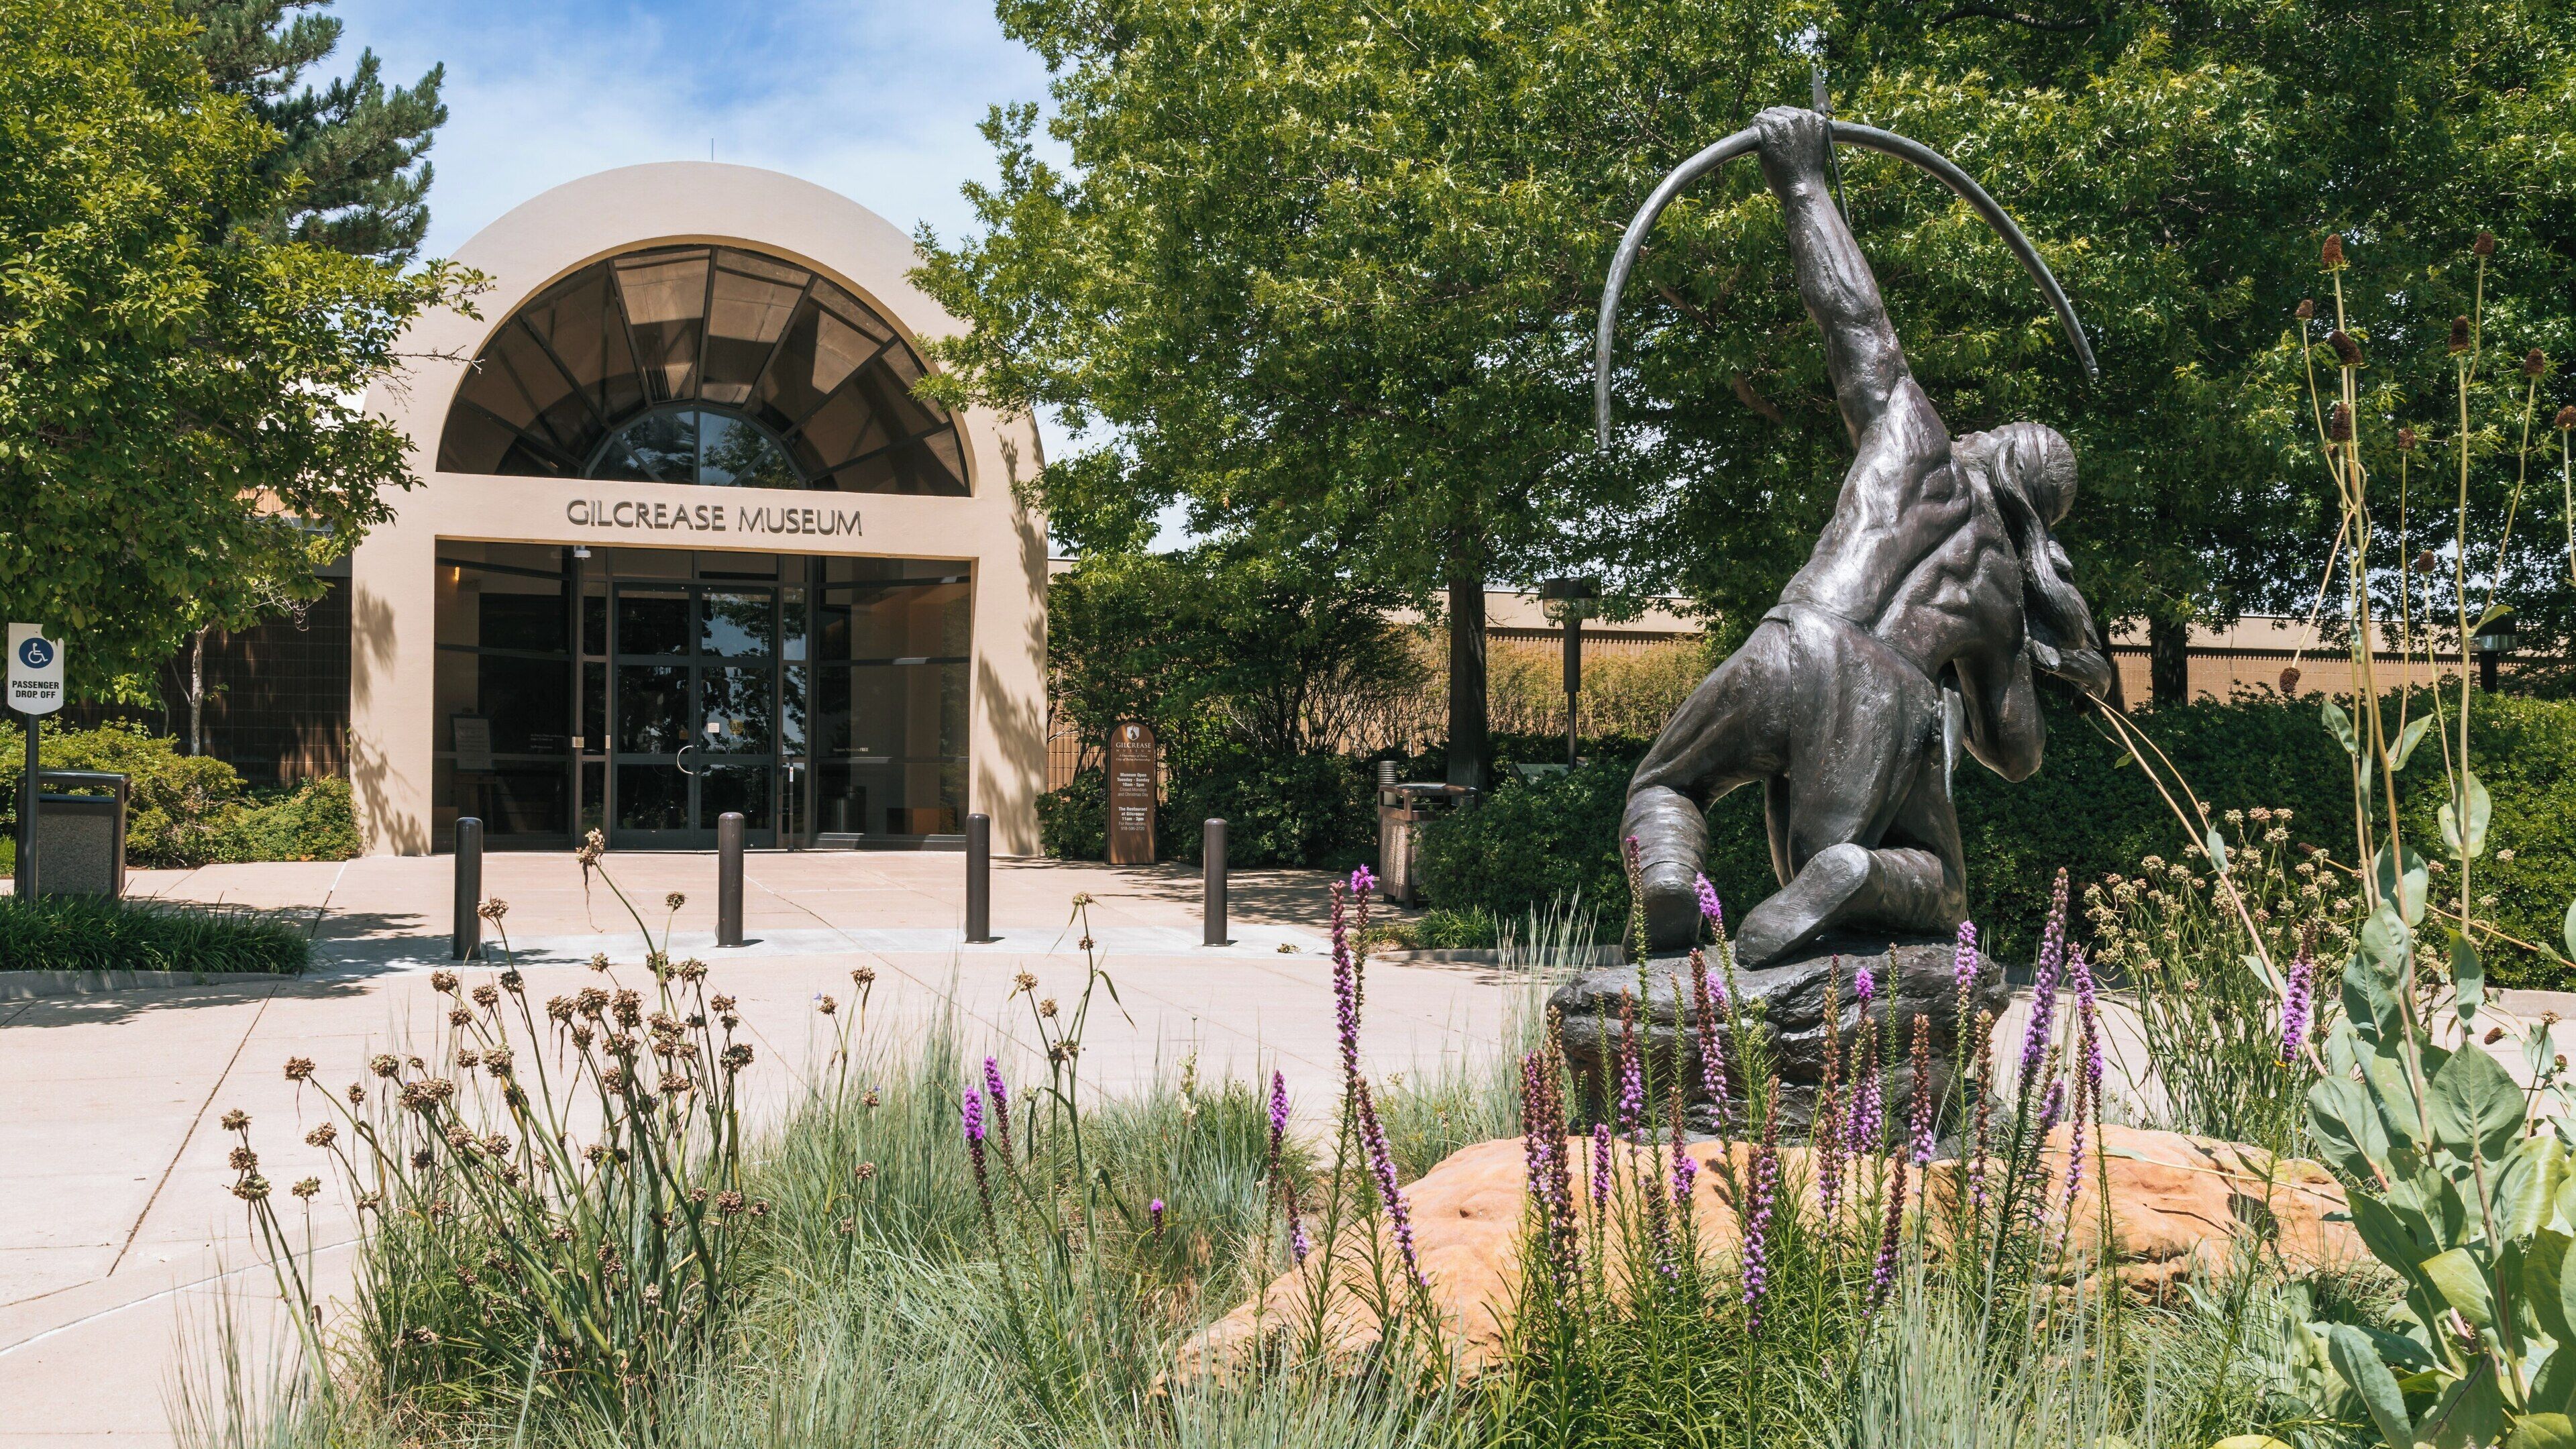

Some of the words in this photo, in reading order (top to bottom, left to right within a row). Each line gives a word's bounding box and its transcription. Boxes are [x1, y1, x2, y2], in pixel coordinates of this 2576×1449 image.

[566, 498, 726, 531] GILCREASE
[738, 506, 863, 536] MUSEUM
[12, 680, 59, 689] PASSENGER
[15, 690, 38, 698] DROP
